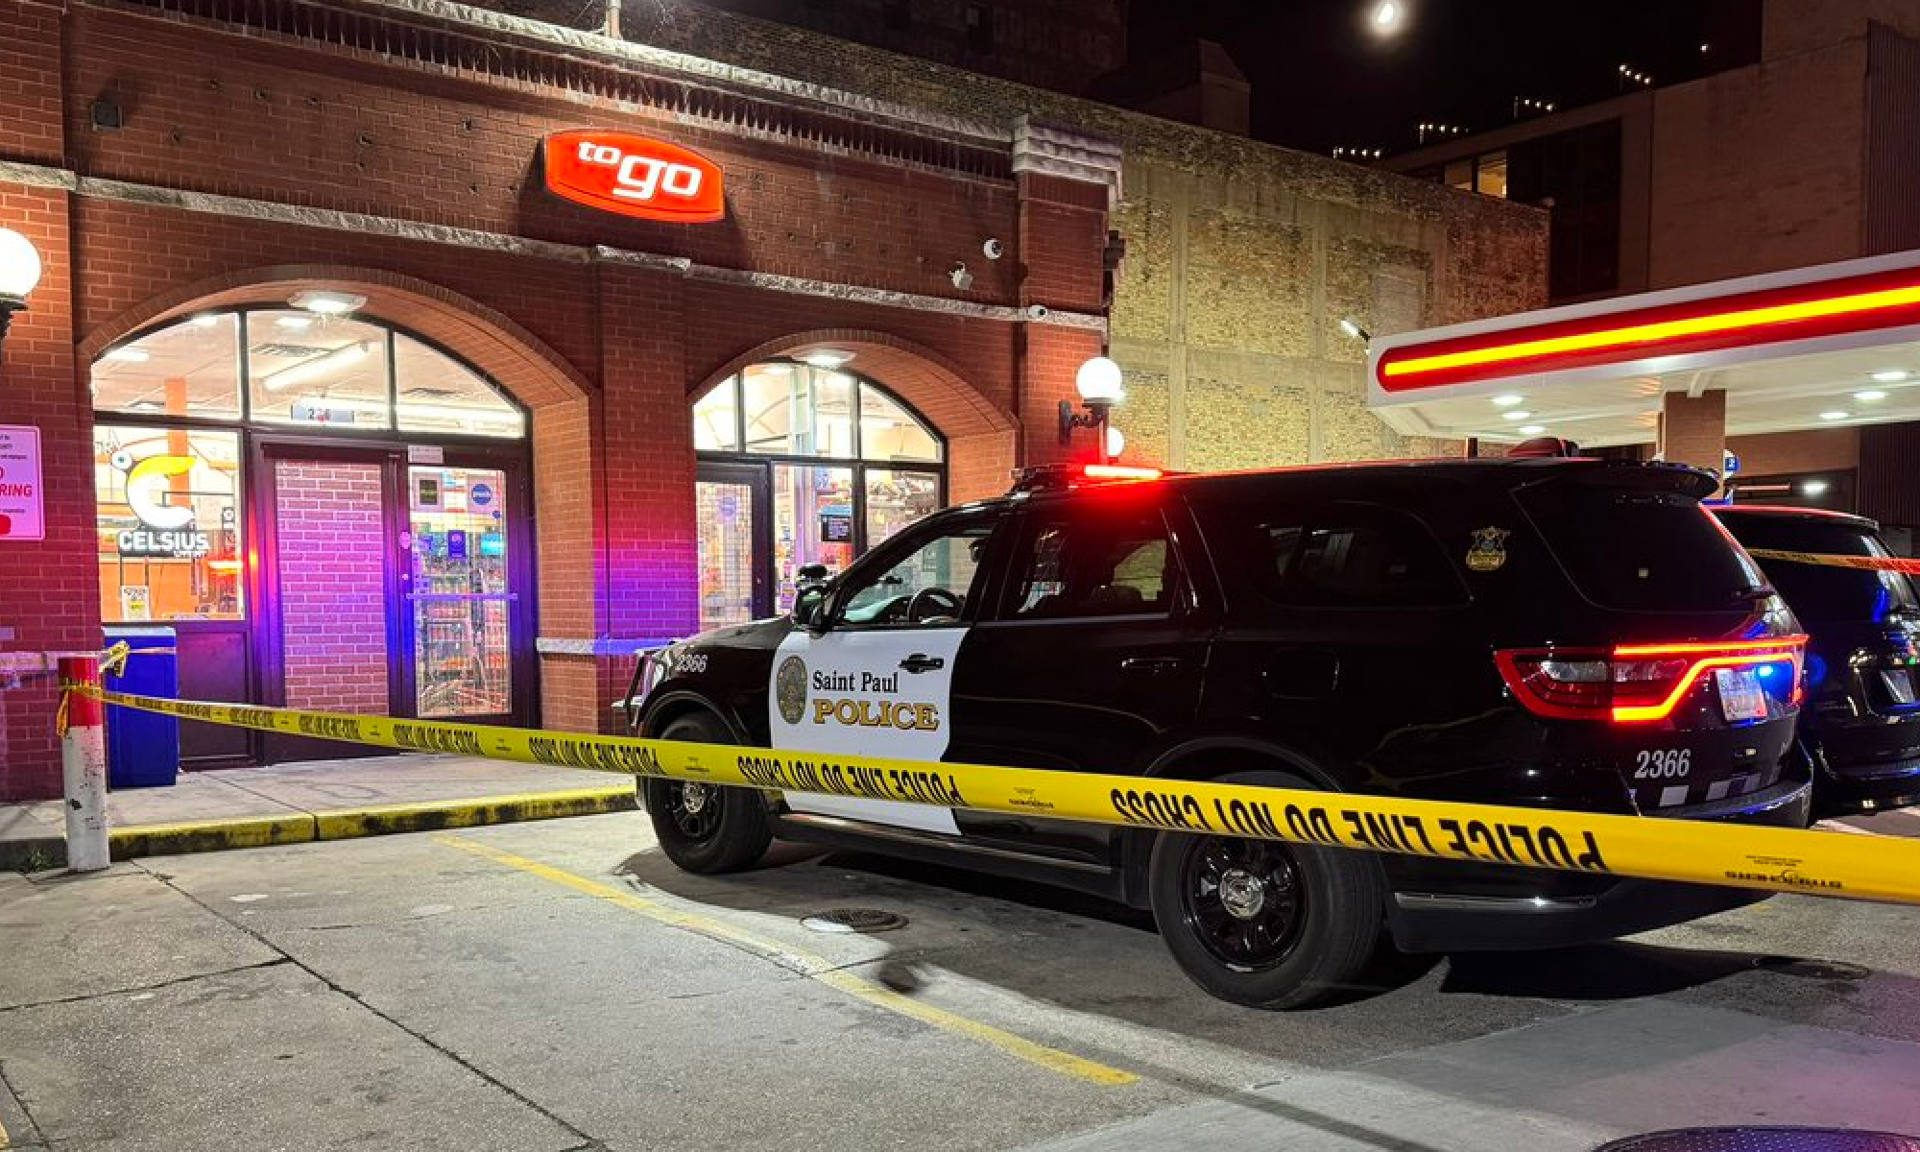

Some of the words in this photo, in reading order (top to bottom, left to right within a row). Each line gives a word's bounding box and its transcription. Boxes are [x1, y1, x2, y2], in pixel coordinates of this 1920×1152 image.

[578, 141, 622, 165] to
[611, 155, 703, 200] go
[119, 531, 210, 550] CELSIUS
[813, 670, 856, 692] Saint
[861, 672, 898, 693] Paul
[813, 699, 939, 731] POLICE
[1635, 748, 1691, 778] 2366
[1110, 788, 1211, 832] CROSS
[1213, 799, 1284, 839] NOT
[1286, 803, 1337, 845] DO
[1341, 810, 1436, 856] LINE
[1438, 819, 1610, 871] POLICE
